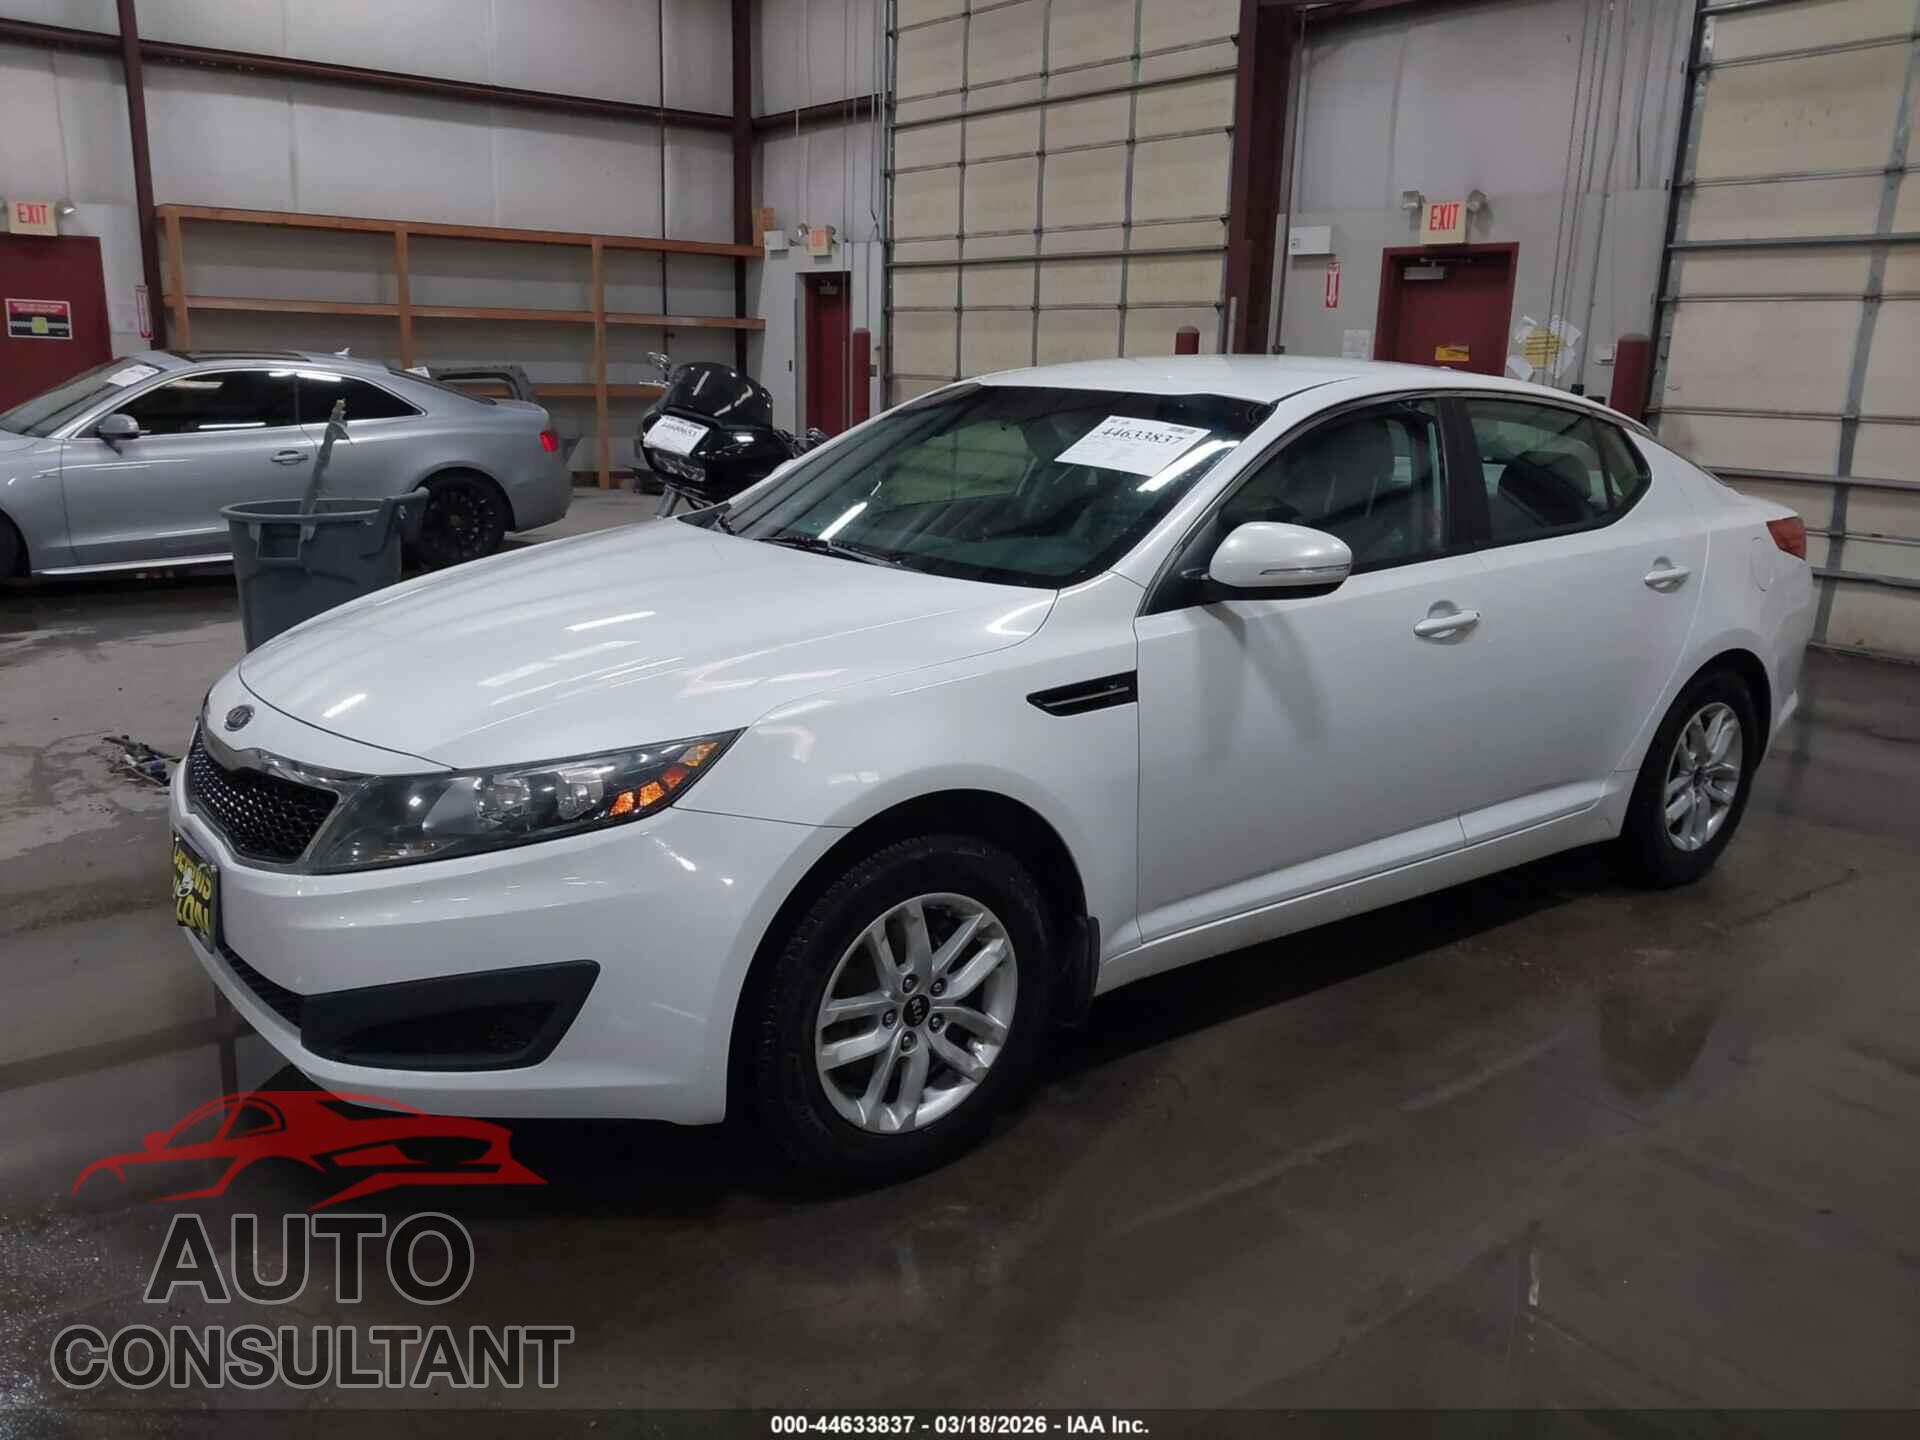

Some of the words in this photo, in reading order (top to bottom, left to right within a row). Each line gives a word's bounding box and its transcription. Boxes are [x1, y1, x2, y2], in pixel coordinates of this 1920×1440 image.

[17, 202, 48, 225] EXIT
[1429, 203, 1461, 231] EXIT
[1101, 426, 1185, 445] 44633837
